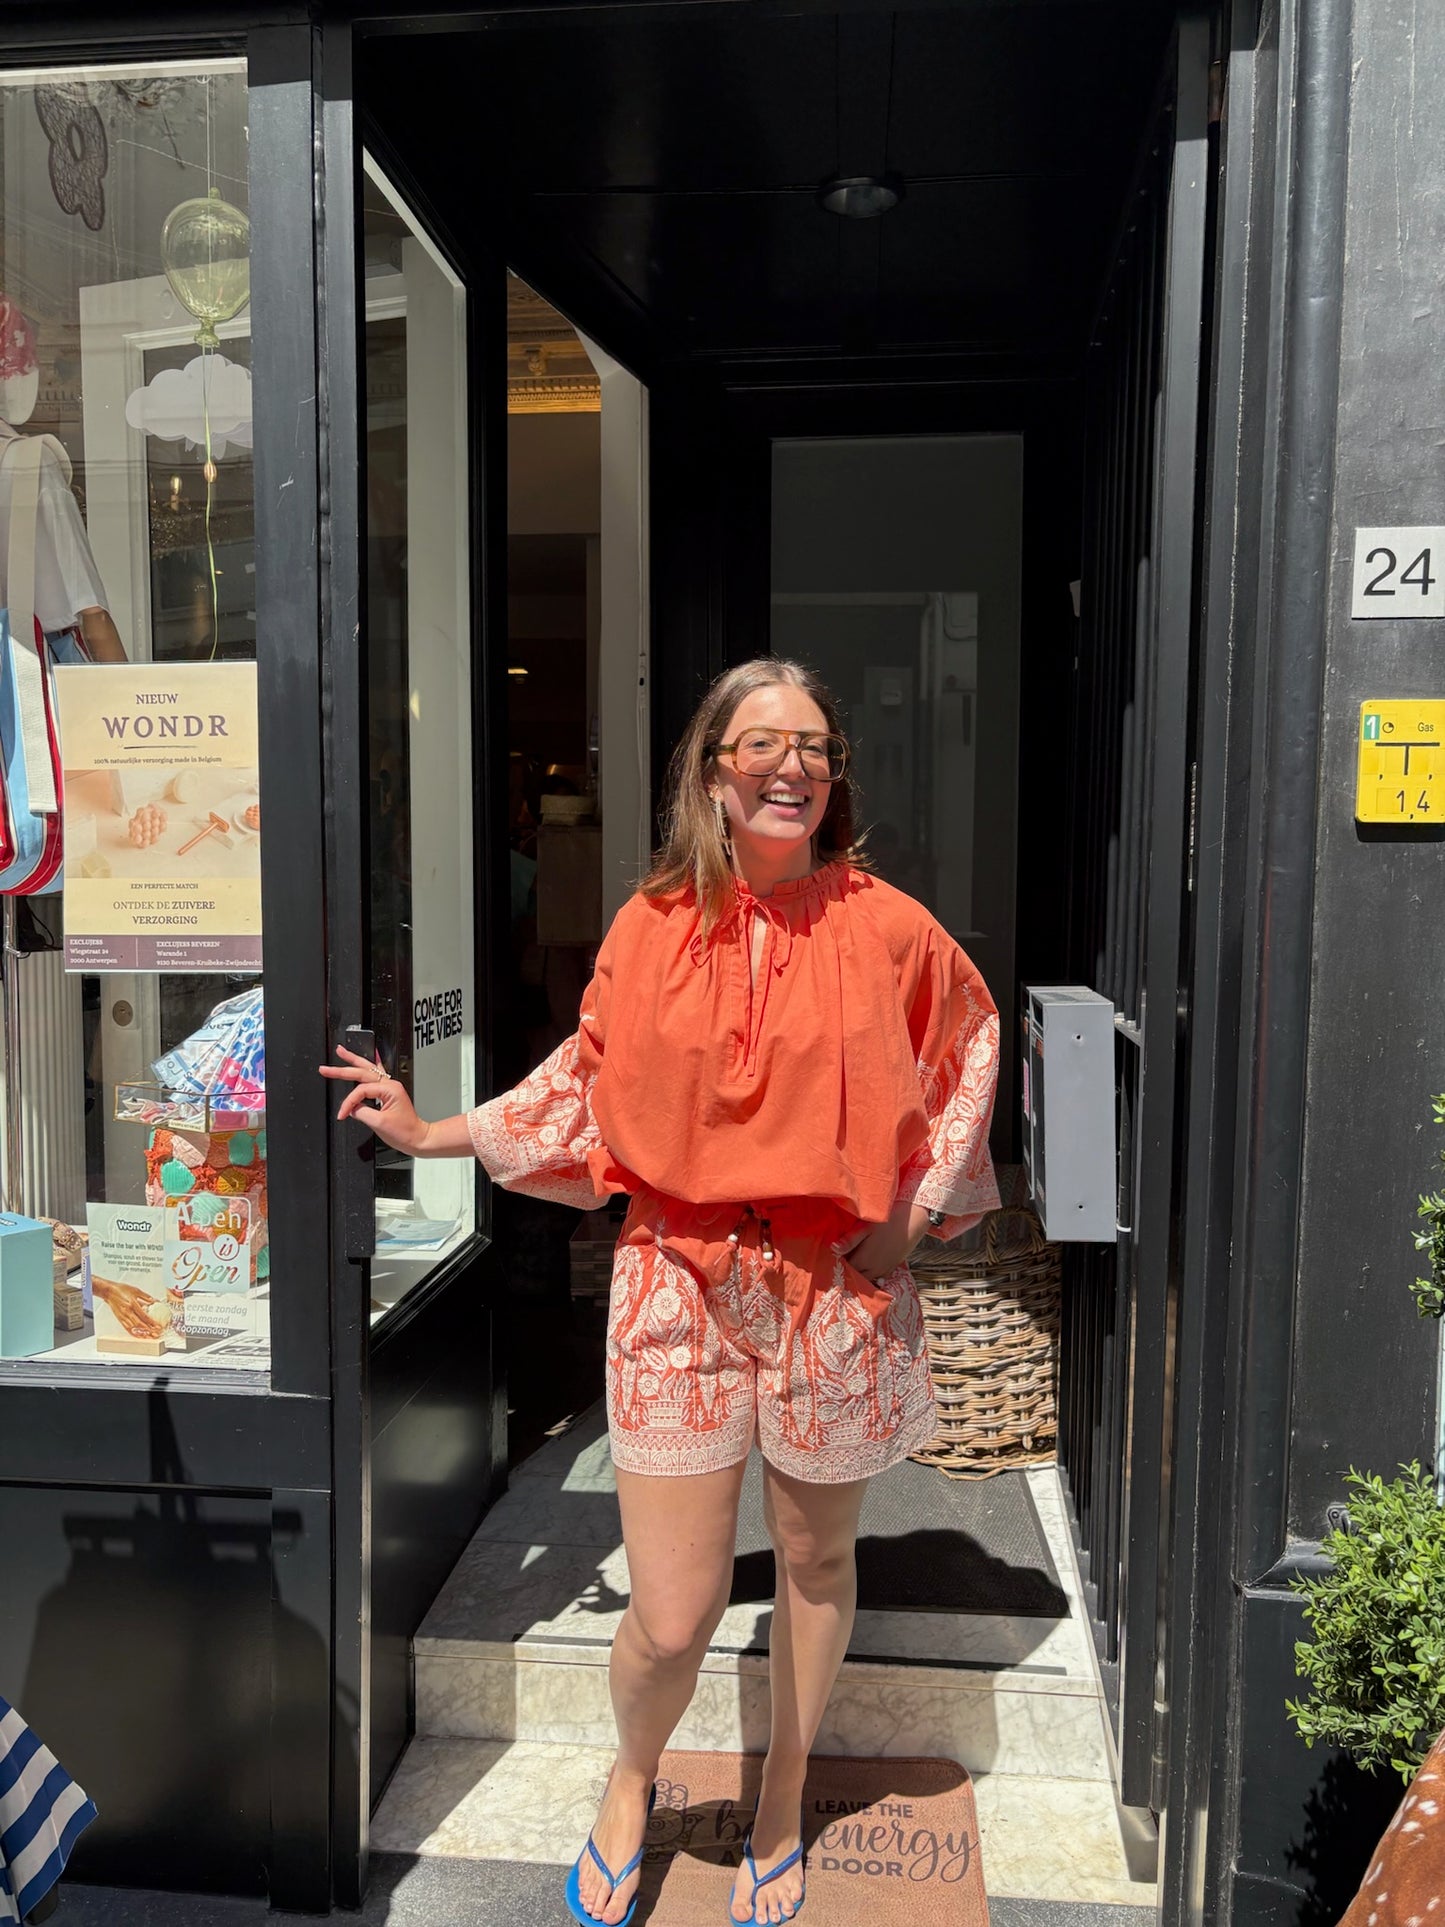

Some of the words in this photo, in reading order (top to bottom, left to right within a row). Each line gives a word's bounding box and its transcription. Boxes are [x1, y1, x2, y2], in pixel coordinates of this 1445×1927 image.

[1363, 547, 1436, 596] 24
[135, 693, 179, 705] NIEUW
[101, 714, 229, 739] WONDR
[1366, 715, 1377, 740] 1
[1417, 721, 1435, 733] Gas
[110, 757, 141, 765] natuurlijke
[142, 757, 173, 765] verzorging
[198, 756, 222, 764] Belgium
[113, 901, 155, 910] ONTDEK
[156, 901, 171, 910] DE
[171, 900, 216, 910] ZUIVERE
[132, 915, 198, 925] VERZORGING
[85, 957, 118, 965] Antwerpen
[414, 993, 443, 1024] COME
[444, 988, 463, 1015] FOR
[414, 1020, 435, 1050] THE
[435, 1010, 463, 1041] VIBES
[117, 1219, 152, 1232] Wondr
[218, 1237, 234, 1257] is
[172, 1246, 241, 1291] Open
[186, 1303, 214, 1313] eerste
[215, 1304, 248, 1317] zondag
[186, 1314, 196, 1323] de
[198, 1315, 230, 1325] maand
[176, 1323, 232, 1338] koopzondag.
[815, 1799, 873, 1816] LEAVE
[878, 1803, 914, 1819] THE
[819, 1818, 980, 1883] energy
[821, 1856, 904, 1877] DOOR
